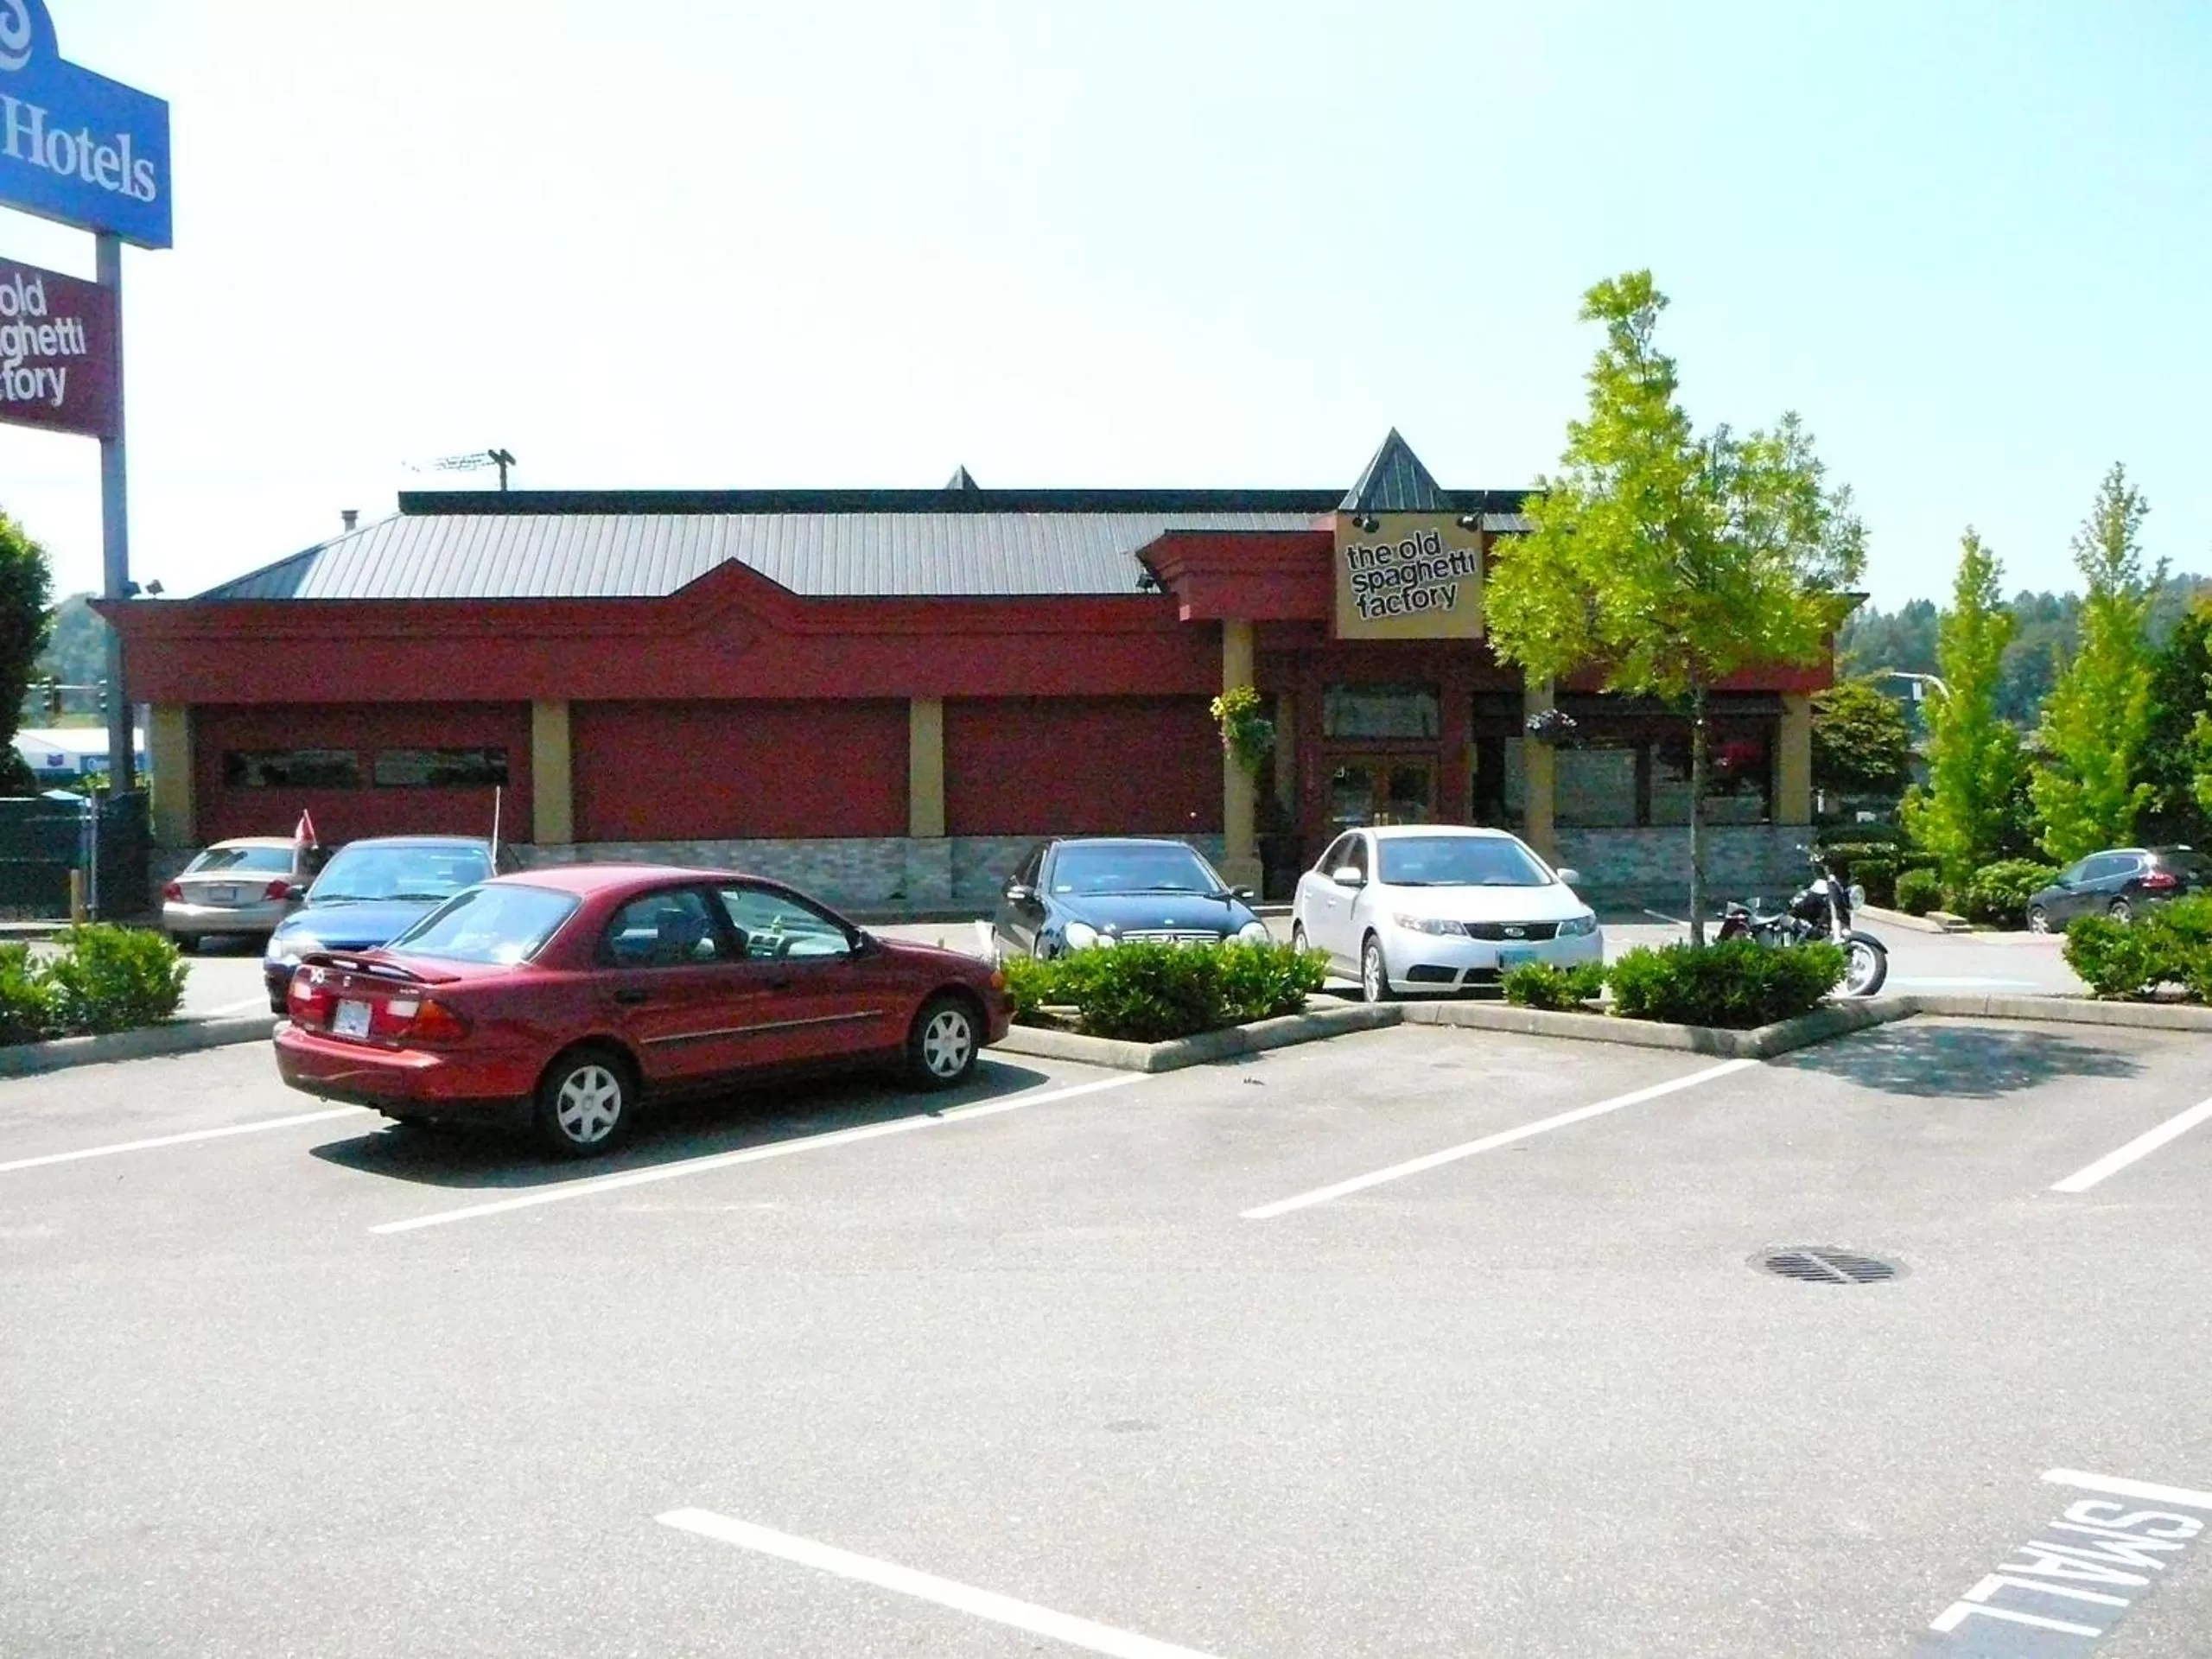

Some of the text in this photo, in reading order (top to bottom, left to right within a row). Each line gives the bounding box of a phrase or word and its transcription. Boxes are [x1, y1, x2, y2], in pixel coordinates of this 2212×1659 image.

[0, 93, 156, 201] Hotels
[0, 272, 48, 316] old
[0, 316, 86, 367] ghetti
[0, 367, 67, 407] tory
[1347, 529, 1442, 569] the old
[1351, 549, 1476, 594] spaghetti
[1356, 582, 1458, 620] factory
[1929, 1499, 2204, 1637] SMALL
